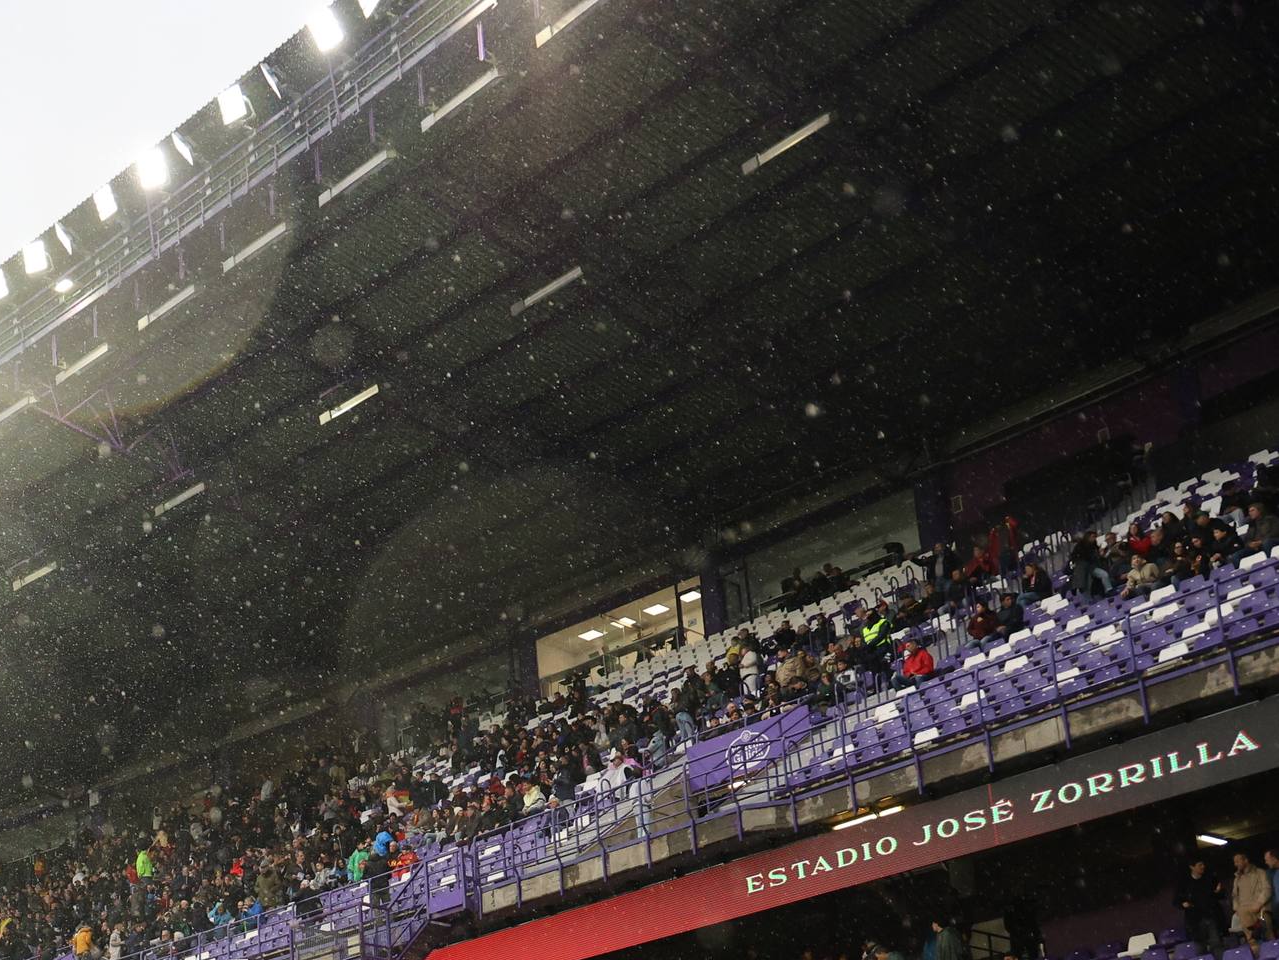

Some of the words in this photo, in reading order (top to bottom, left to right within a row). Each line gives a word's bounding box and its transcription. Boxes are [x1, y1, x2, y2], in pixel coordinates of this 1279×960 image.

[746, 836, 898, 894] ESTADIO
[913, 799, 1014, 847] JOSÉ
[1030, 730, 1259, 814] ZORRILLA
